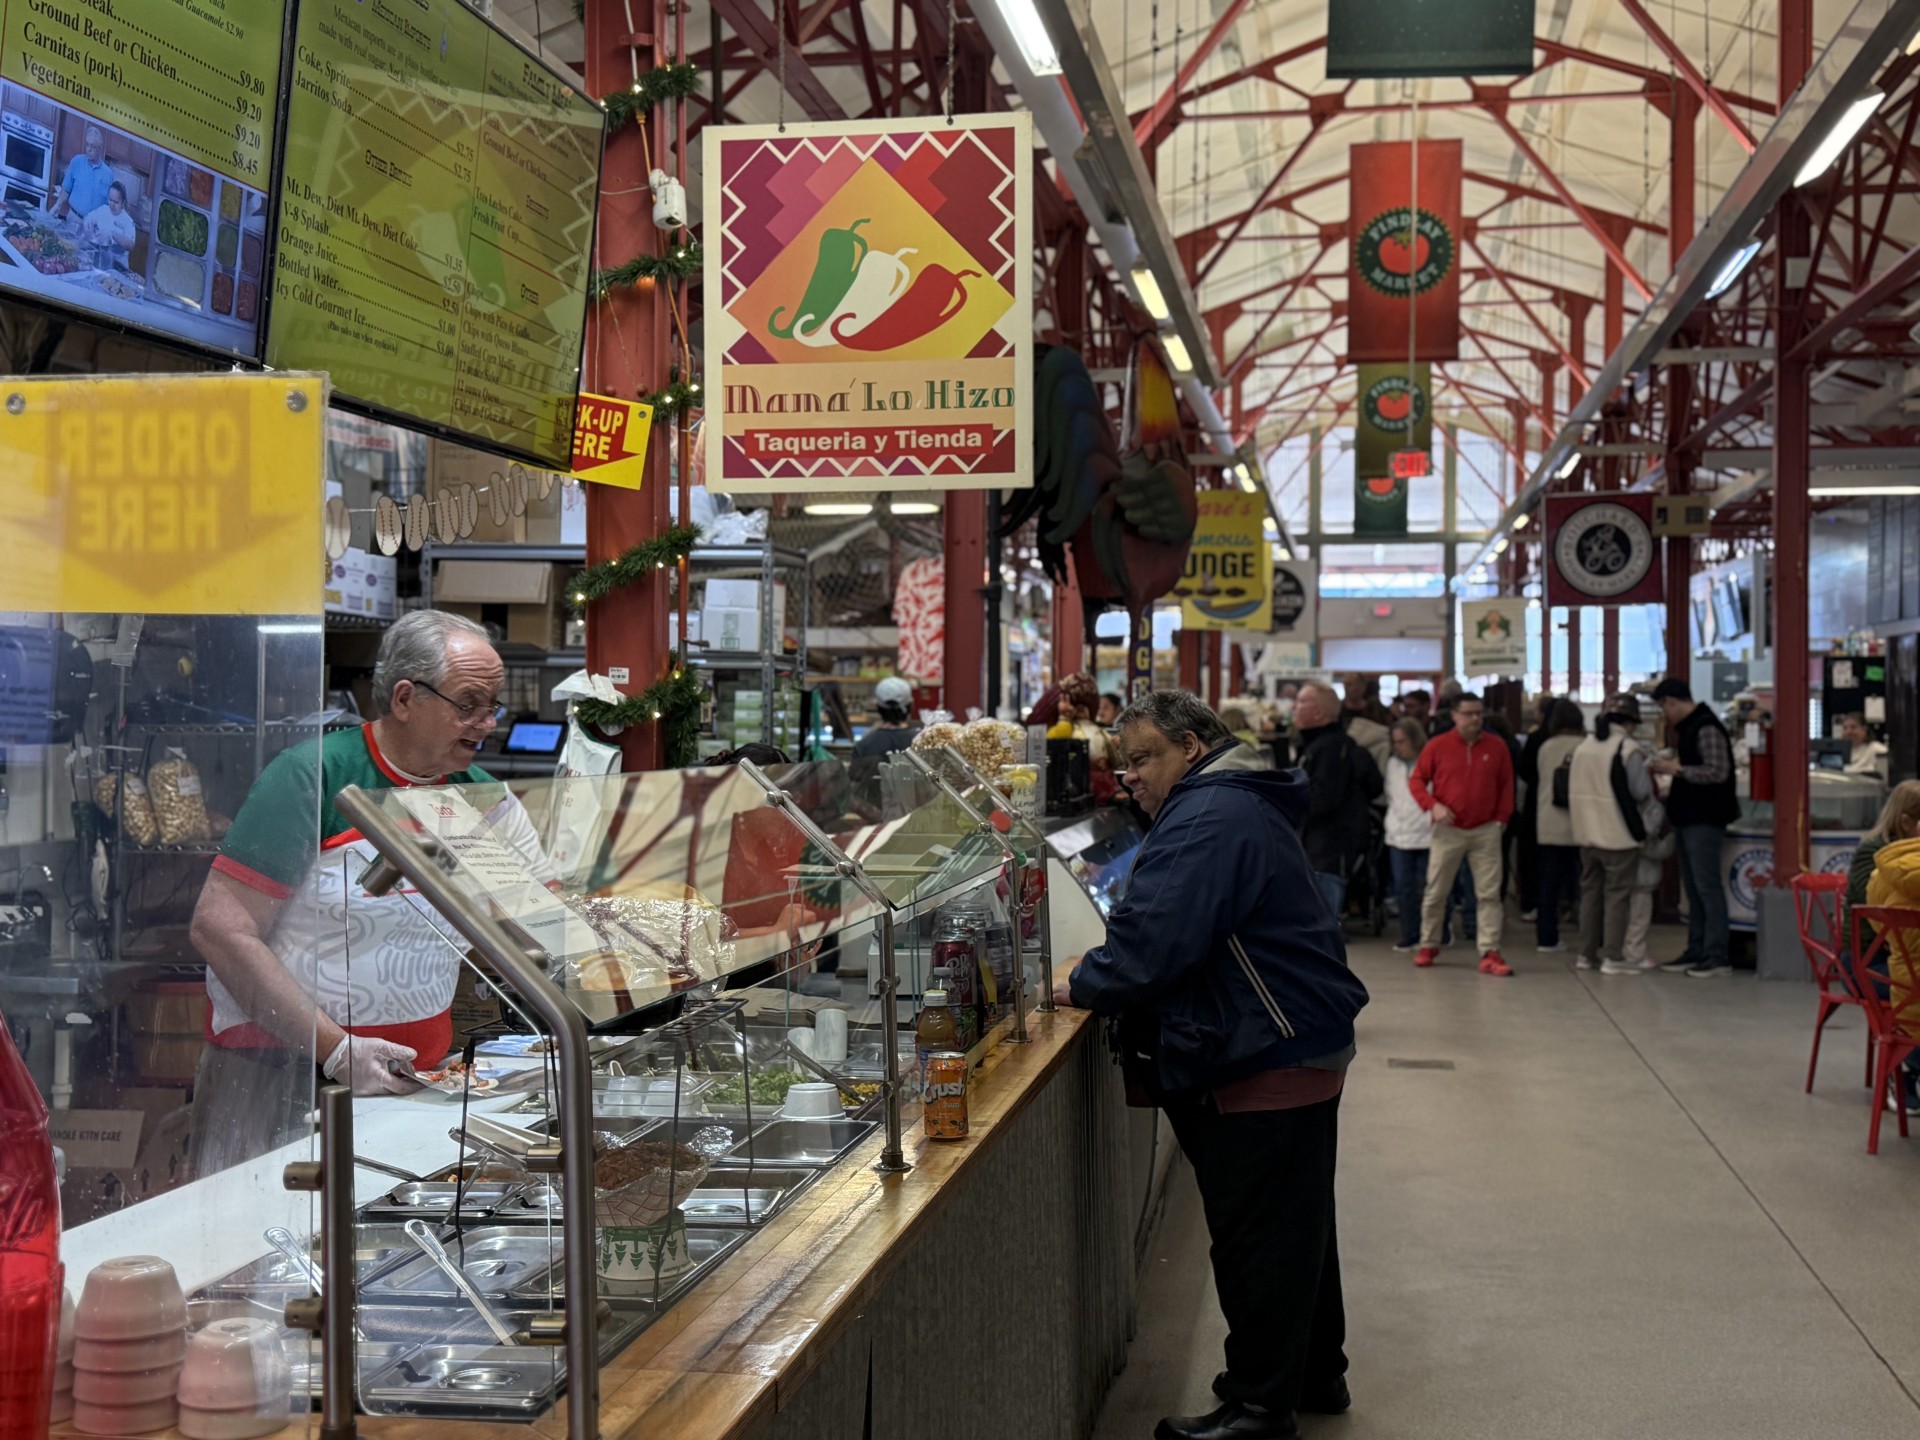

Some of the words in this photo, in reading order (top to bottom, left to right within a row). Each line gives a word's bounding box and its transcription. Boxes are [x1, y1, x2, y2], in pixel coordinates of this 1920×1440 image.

[334, 4, 361, 34] Mexican
[28, 0, 79, 31] Ground
[84, 17, 113, 47] Beef
[114, 38, 128, 55] or
[130, 42, 177, 80] Chicken
[236, 96, 262, 123] $9.20
[24, 21, 81, 64] Carnitas
[84, 51, 123, 88] (pork)
[235, 123, 261, 150] $9.20
[240, 70, 265, 97] $9.80
[22, 51, 91, 100] Vegetarian
[232, 150, 258, 175] $8.45
[298, 45, 323, 74] Coke,
[325, 61, 351, 88] Sprite
[456, 143, 474, 162] $2.75
[295, 70, 330, 102] Jarritos
[331, 91, 353, 115] Soda
[453, 162, 471, 183] $2.75
[283, 201, 299, 222] V-8
[300, 211, 329, 236] Splash
[285, 176, 301, 197] Mt.
[303, 184, 324, 210] Dew,
[326, 194, 344, 218] Diet
[346, 205, 360, 225] Mt.
[362, 212, 381, 237] Dew,
[382, 221, 399, 243] Diet
[400, 230, 419, 252] Coke
[281, 226, 314, 256] Orange
[315, 242, 338, 265] Juice
[279, 251, 310, 279] Bottled
[313, 265, 339, 291] Water
[275, 276, 289, 301] Icy
[292, 284, 313, 306] Cold
[315, 293, 352, 320] Gourmet
[353, 307, 366, 327] Ice
[862, 381, 913, 412] Lo
[925, 379, 1016, 410] Hizo
[573, 430, 612, 461] ERE
[754, 430, 867, 454] Taqueria
[873, 434, 888, 453] y
[894, 428, 983, 449] Tienda
[1183, 551, 1255, 580] UDGE
[923, 1077, 966, 1103] Crush
[51, 1130, 77, 1141] ANDLE
